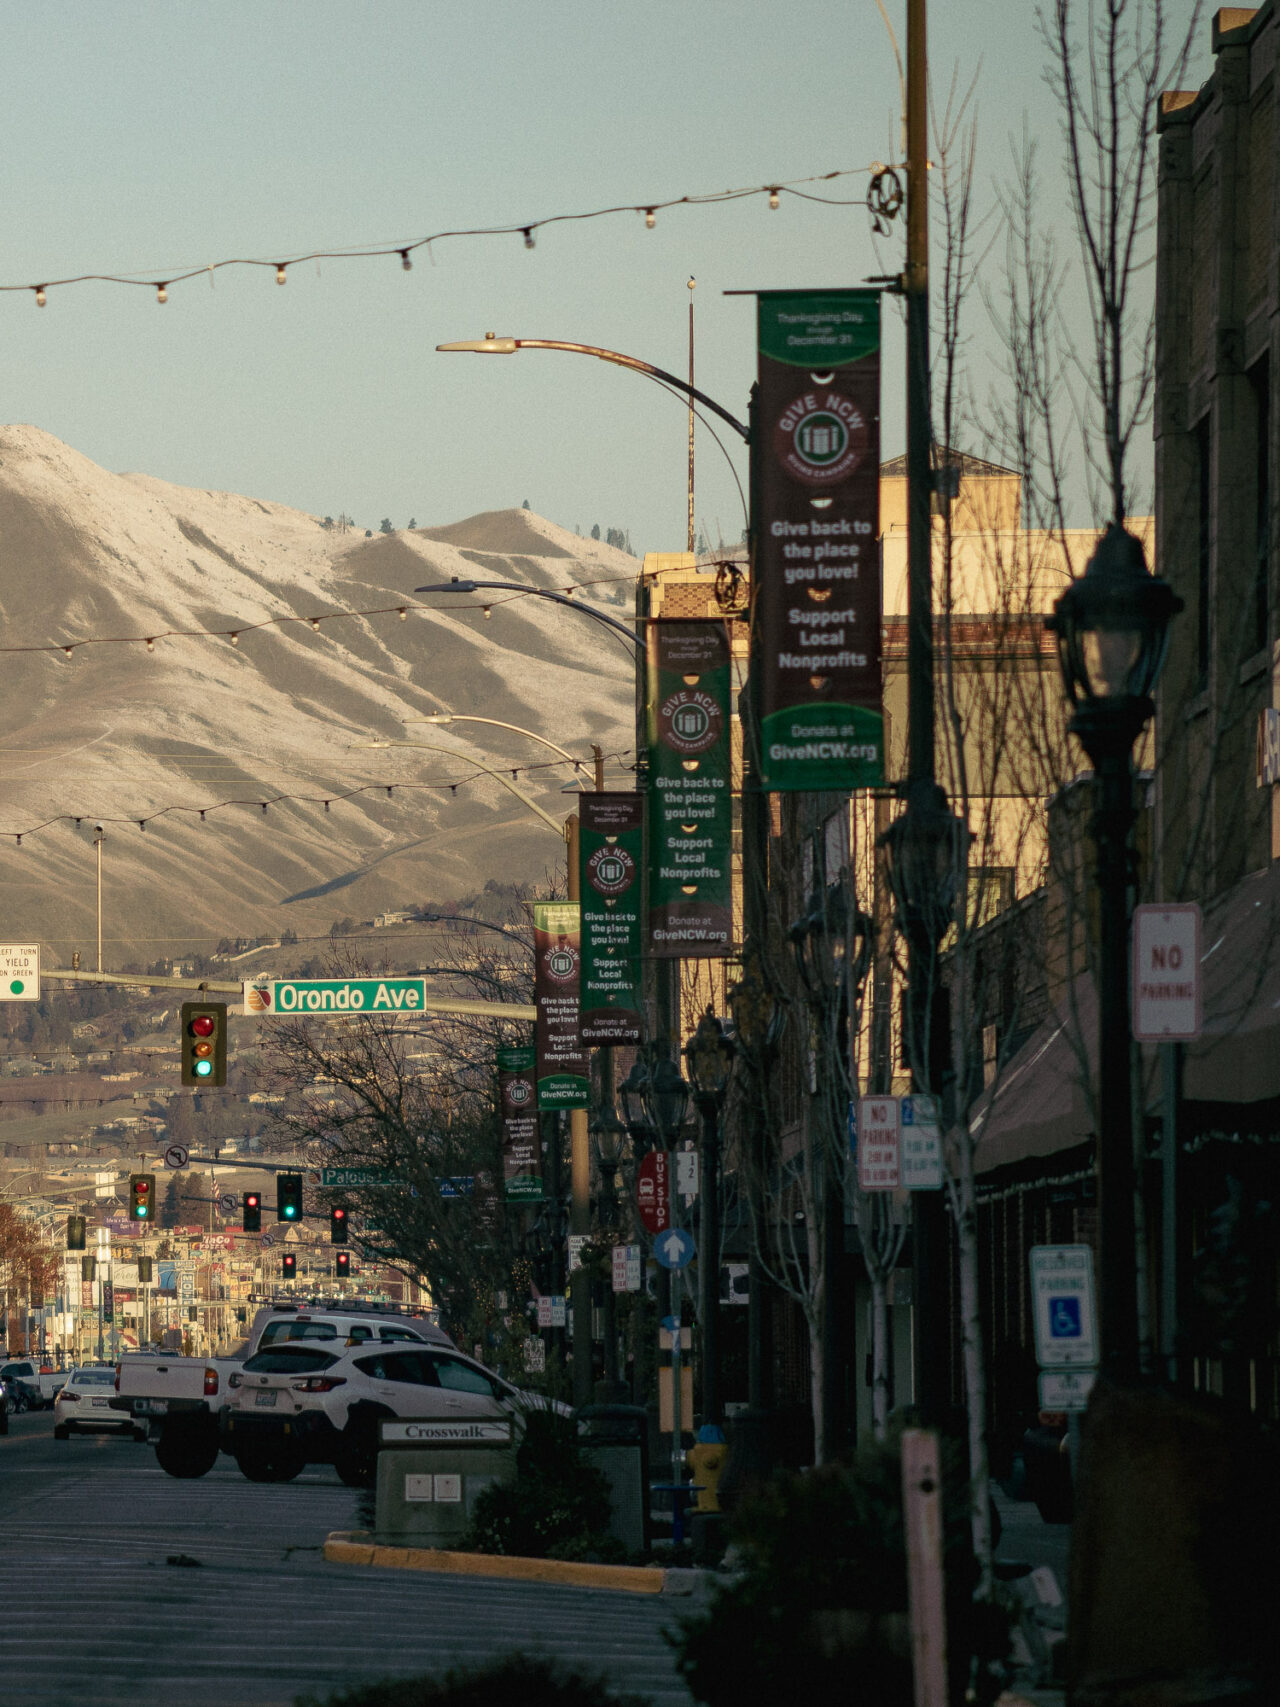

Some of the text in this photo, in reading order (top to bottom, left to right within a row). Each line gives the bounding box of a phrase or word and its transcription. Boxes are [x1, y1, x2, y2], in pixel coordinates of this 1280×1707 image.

[778, 312, 864, 325] Thanksgiving Day
[787, 335, 853, 346] December 31
[779, 394, 865, 432] GIVE NCW
[771, 520, 872, 537] Give back to
[784, 543, 859, 561] the place
[784, 564, 859, 584] you love!
[789, 609, 856, 628] Support
[661, 636, 719, 646] Thanksgiving Day
[800, 630, 844, 646] Local
[778, 653, 867, 671] Nonprofits
[661, 692, 720, 717] GIVE NCW
[791, 725, 855, 738] Donate at
[769, 744, 878, 762] GiveNCW.org
[656, 777, 724, 788] Give back to
[664, 792, 716, 804] the place
[664, 807, 715, 820] you love!
[667, 837, 713, 850] Support
[590, 848, 633, 867] GIVE NCW
[675, 853, 705, 863] Local
[660, 867, 720, 880] Nonprofits
[584, 912, 604, 921] Give
[626, 912, 636, 921] to
[668, 916, 712, 925] Donate at
[591, 924, 630, 934] the place
[591, 937, 607, 945] you
[653, 930, 727, 942] GiveNCW.org
[544, 945, 580, 961] GIVE NCW
[1152, 945, 1183, 971] NO
[6, 958, 29, 967] YIELD
[593, 958, 627, 968] Support
[599, 970, 621, 978] Local
[588, 981, 633, 991] Nonprofits
[1141, 982, 1193, 998] PARKING
[280, 983, 420, 1010] Orondo Ave
[541, 997, 557, 1005] Give
[546, 1006, 579, 1015] the place
[547, 1017, 560, 1025] you
[548, 1034, 577, 1042] Support
[582, 1028, 639, 1038] GiveNCW.org
[544, 1053, 582, 1061] Nonprofits
[506, 1079, 533, 1092] GIVE NCW
[541, 1091, 587, 1099] GiveNCW.org
[871, 1105, 887, 1122] NO
[864, 1129, 896, 1145] PARKING
[690, 1155, 695, 1165] 1
[656, 1153, 665, 1183] BUS
[688, 1168, 694, 1178] 2
[656, 1187, 665, 1227] STOP
[405, 1425, 484, 1438] Crosswalk
